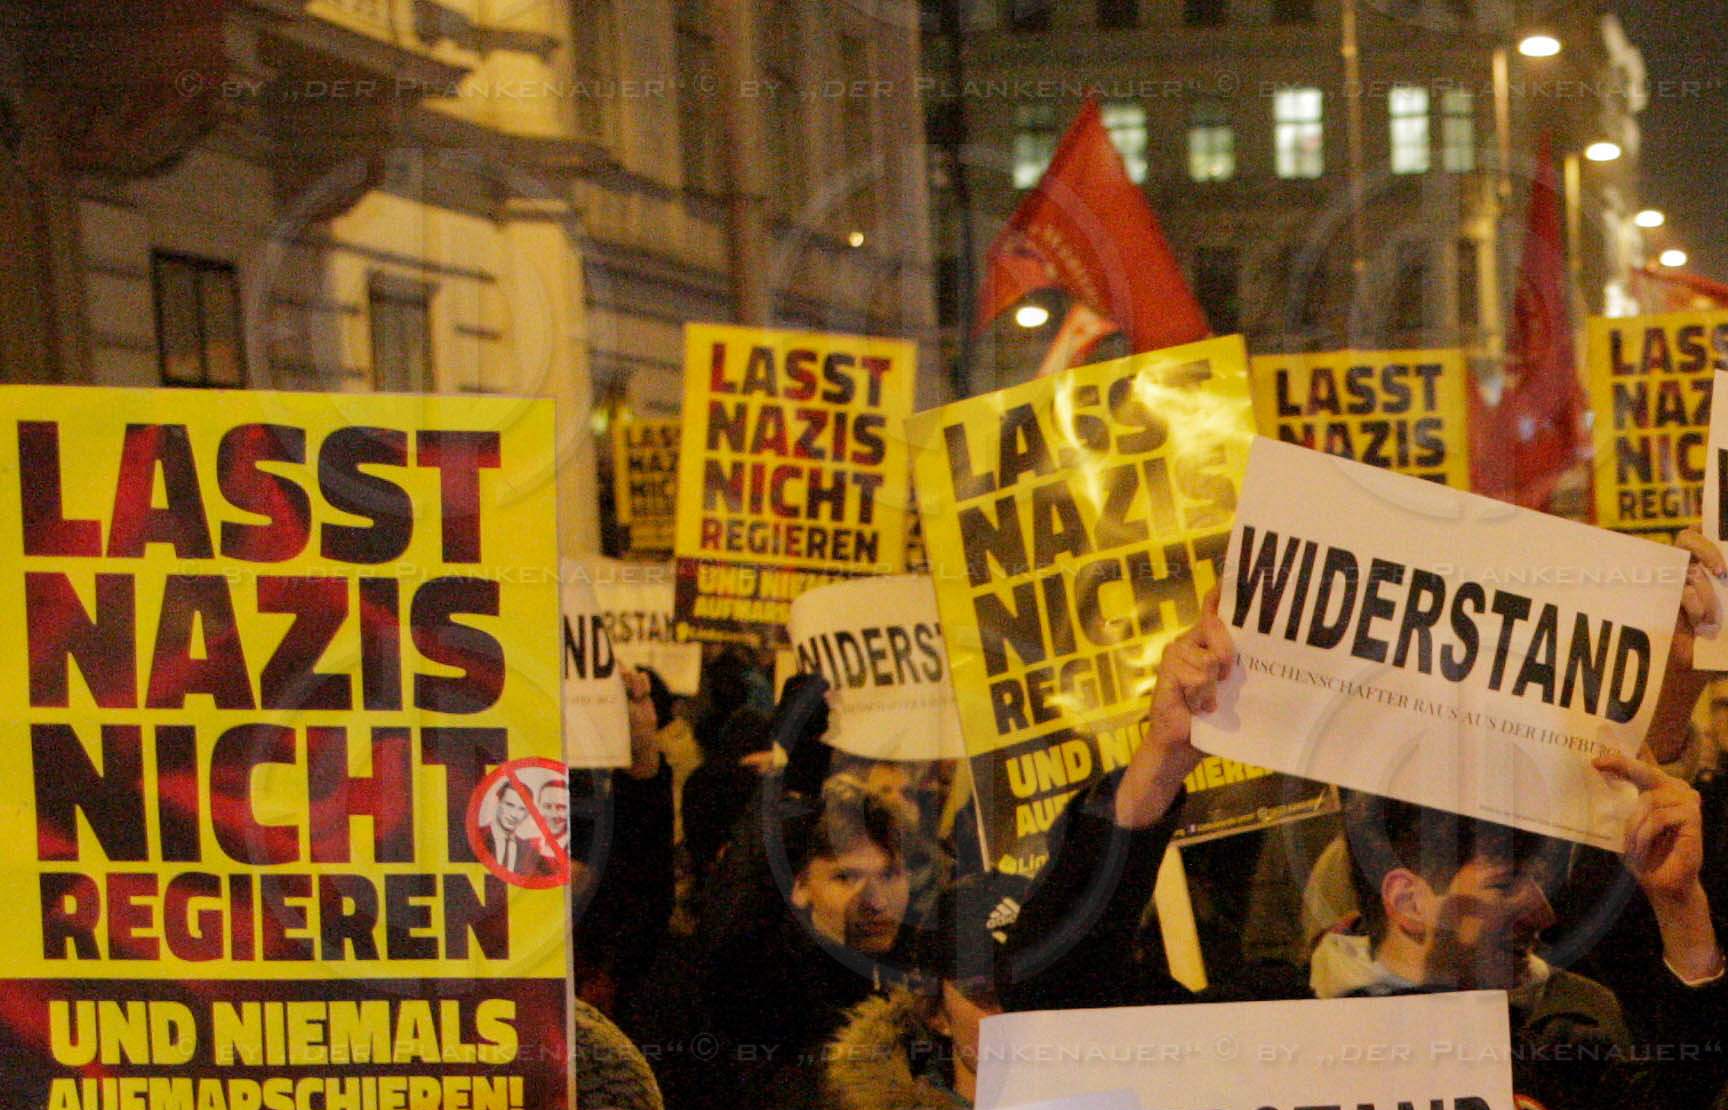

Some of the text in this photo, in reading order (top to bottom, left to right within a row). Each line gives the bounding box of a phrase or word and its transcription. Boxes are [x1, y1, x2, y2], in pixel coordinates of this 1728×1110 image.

[710, 343, 892, 407] LASST
[1276, 363, 1443, 417] LASST
[1612, 377, 1714, 431] NAZ
[706, 400, 887, 467] NAZIS
[1615, 432, 1705, 485] NIC
[17, 420, 501, 564] LASST
[703, 459, 885, 524] NICHT
[957, 443, 1239, 588] NAZIS
[1617, 487, 1703, 521] REGI
[700, 518, 880, 565] REGIEREN
[24, 570, 506, 714] NAZIS
[1231, 526, 1652, 725] WIDERSTAND
[1235, 653, 1409, 709] URSCHENSCHAFTER
[1501, 718, 1536, 739] DER
[30, 722, 509, 865] NICHT
[1006, 738, 1093, 799] UND
[39, 872, 511, 962] REGIEREN
[48, 998, 519, 1066] UND NIEMALS
